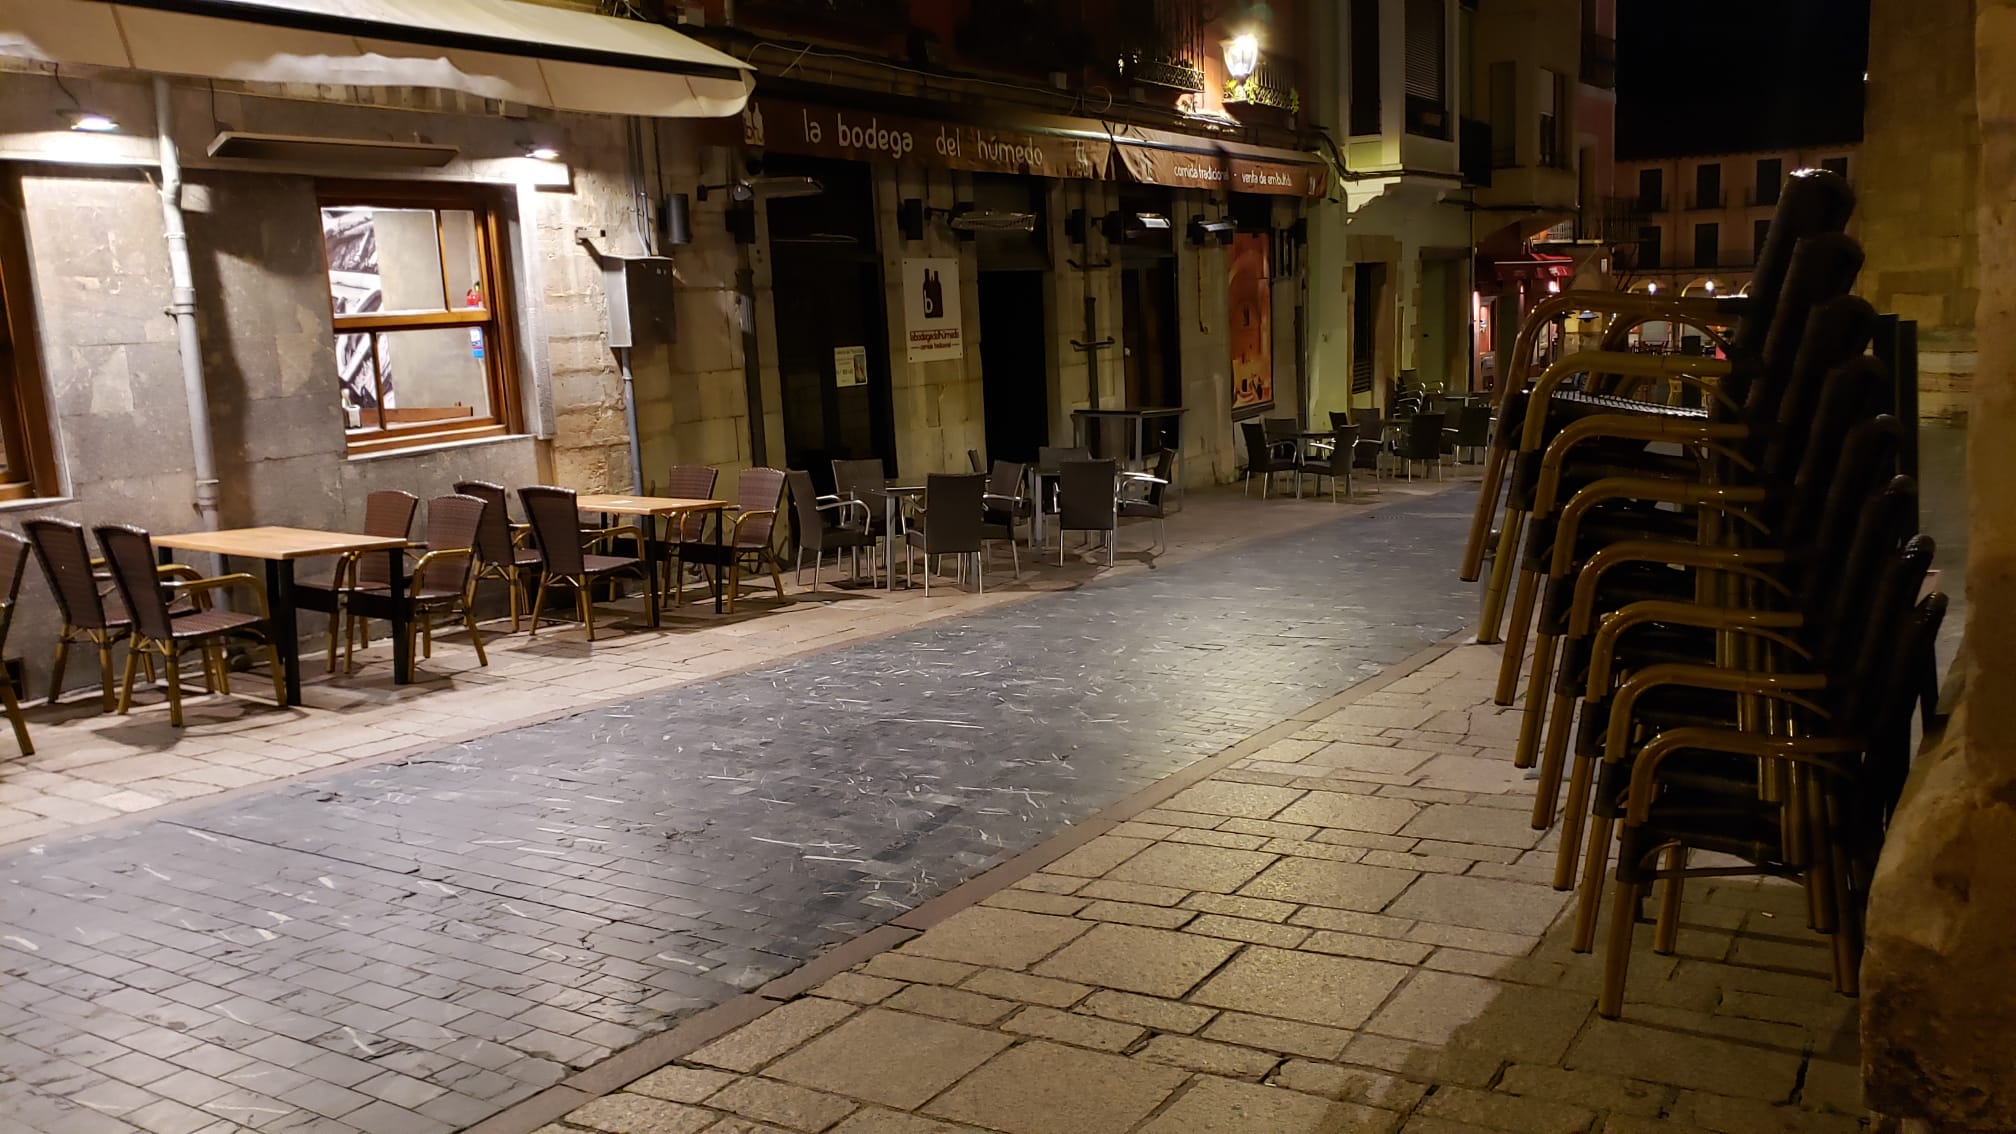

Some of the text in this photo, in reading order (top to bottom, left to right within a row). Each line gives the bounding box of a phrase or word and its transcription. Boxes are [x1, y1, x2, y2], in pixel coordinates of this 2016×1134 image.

[803, 108, 1043, 166] la bodega del húmedo
[1174, 163, 1198, 179] comida
[1241, 169, 1258, 184] venta
[1259, 170, 1266, 185] de
[924, 289, 933, 313] b
